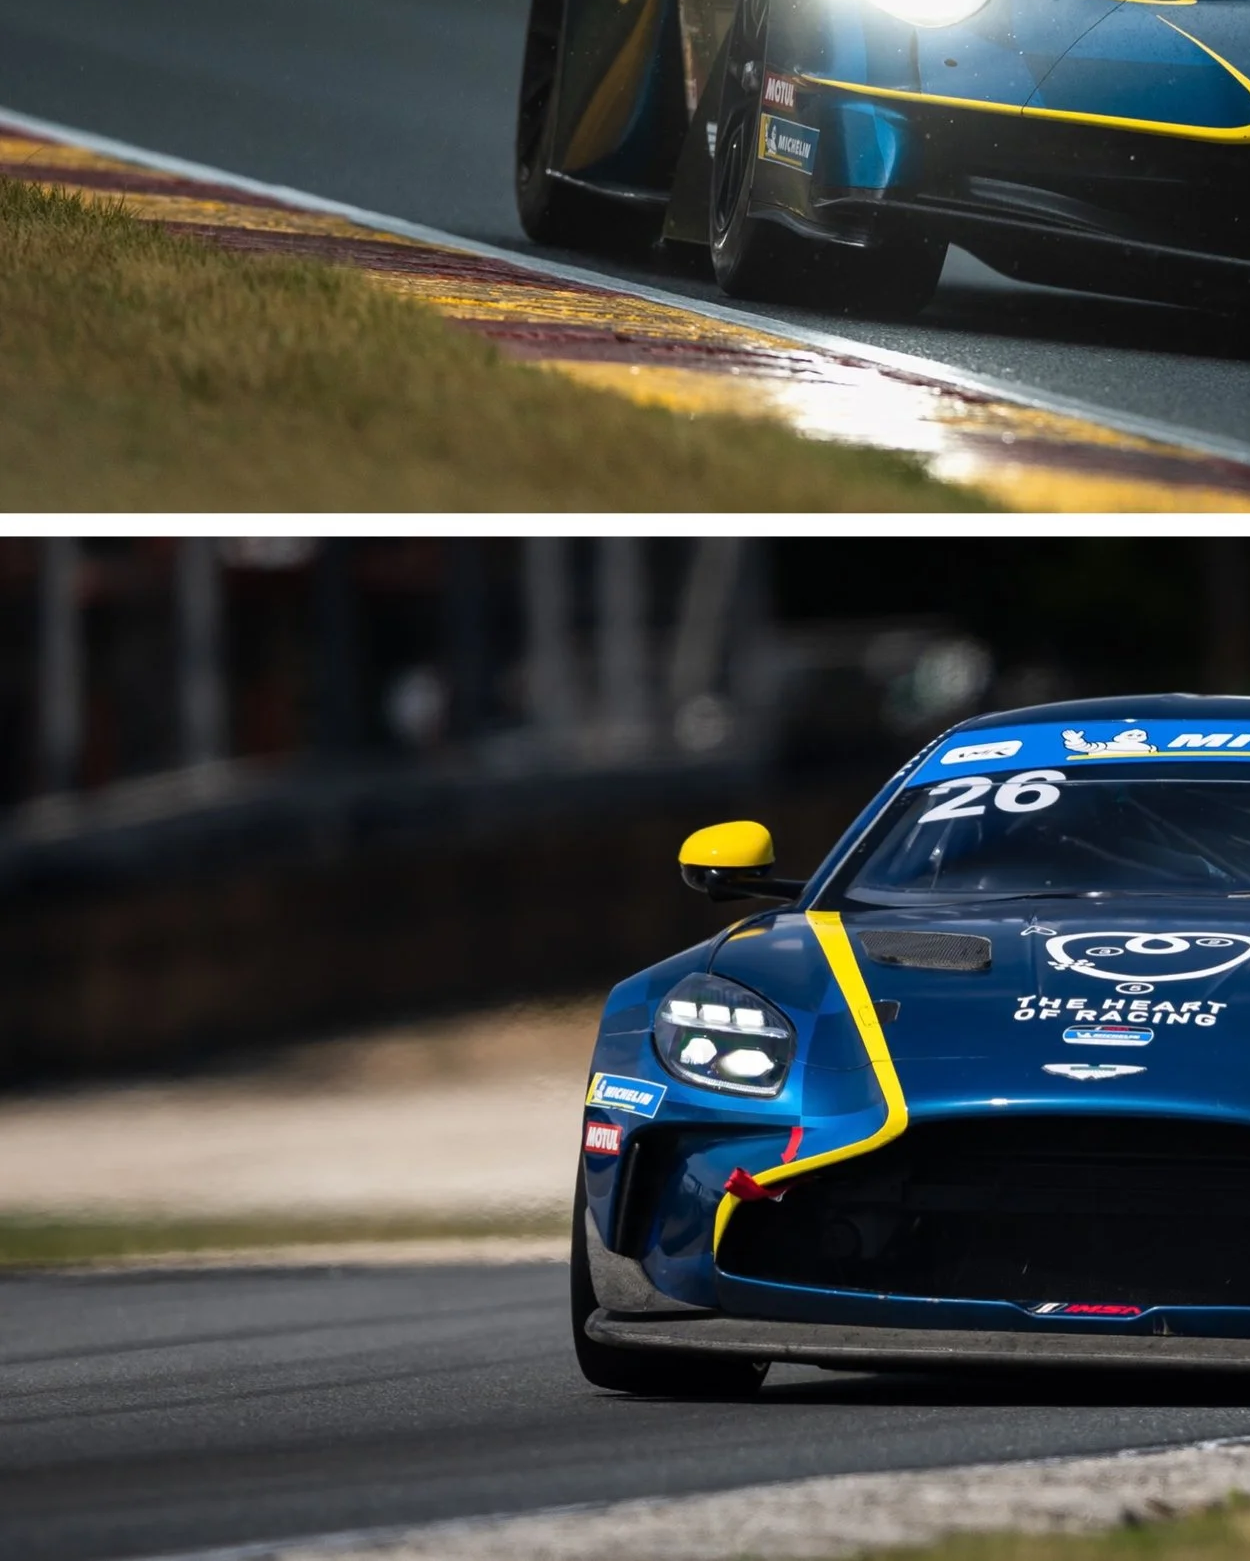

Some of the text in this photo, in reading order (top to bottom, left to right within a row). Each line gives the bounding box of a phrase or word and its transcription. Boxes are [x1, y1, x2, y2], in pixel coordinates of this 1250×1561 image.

[765, 77, 794, 107] MOTUL
[778, 134, 811, 159] MICHELIN
[916, 769, 1067, 824] 26
[1013, 1008, 1217, 1027] OF RACING
[1017, 995, 1228, 1015] THE HEART
[603, 1085, 654, 1106] MICHELIN
[585, 1126, 619, 1151] MOTUL
